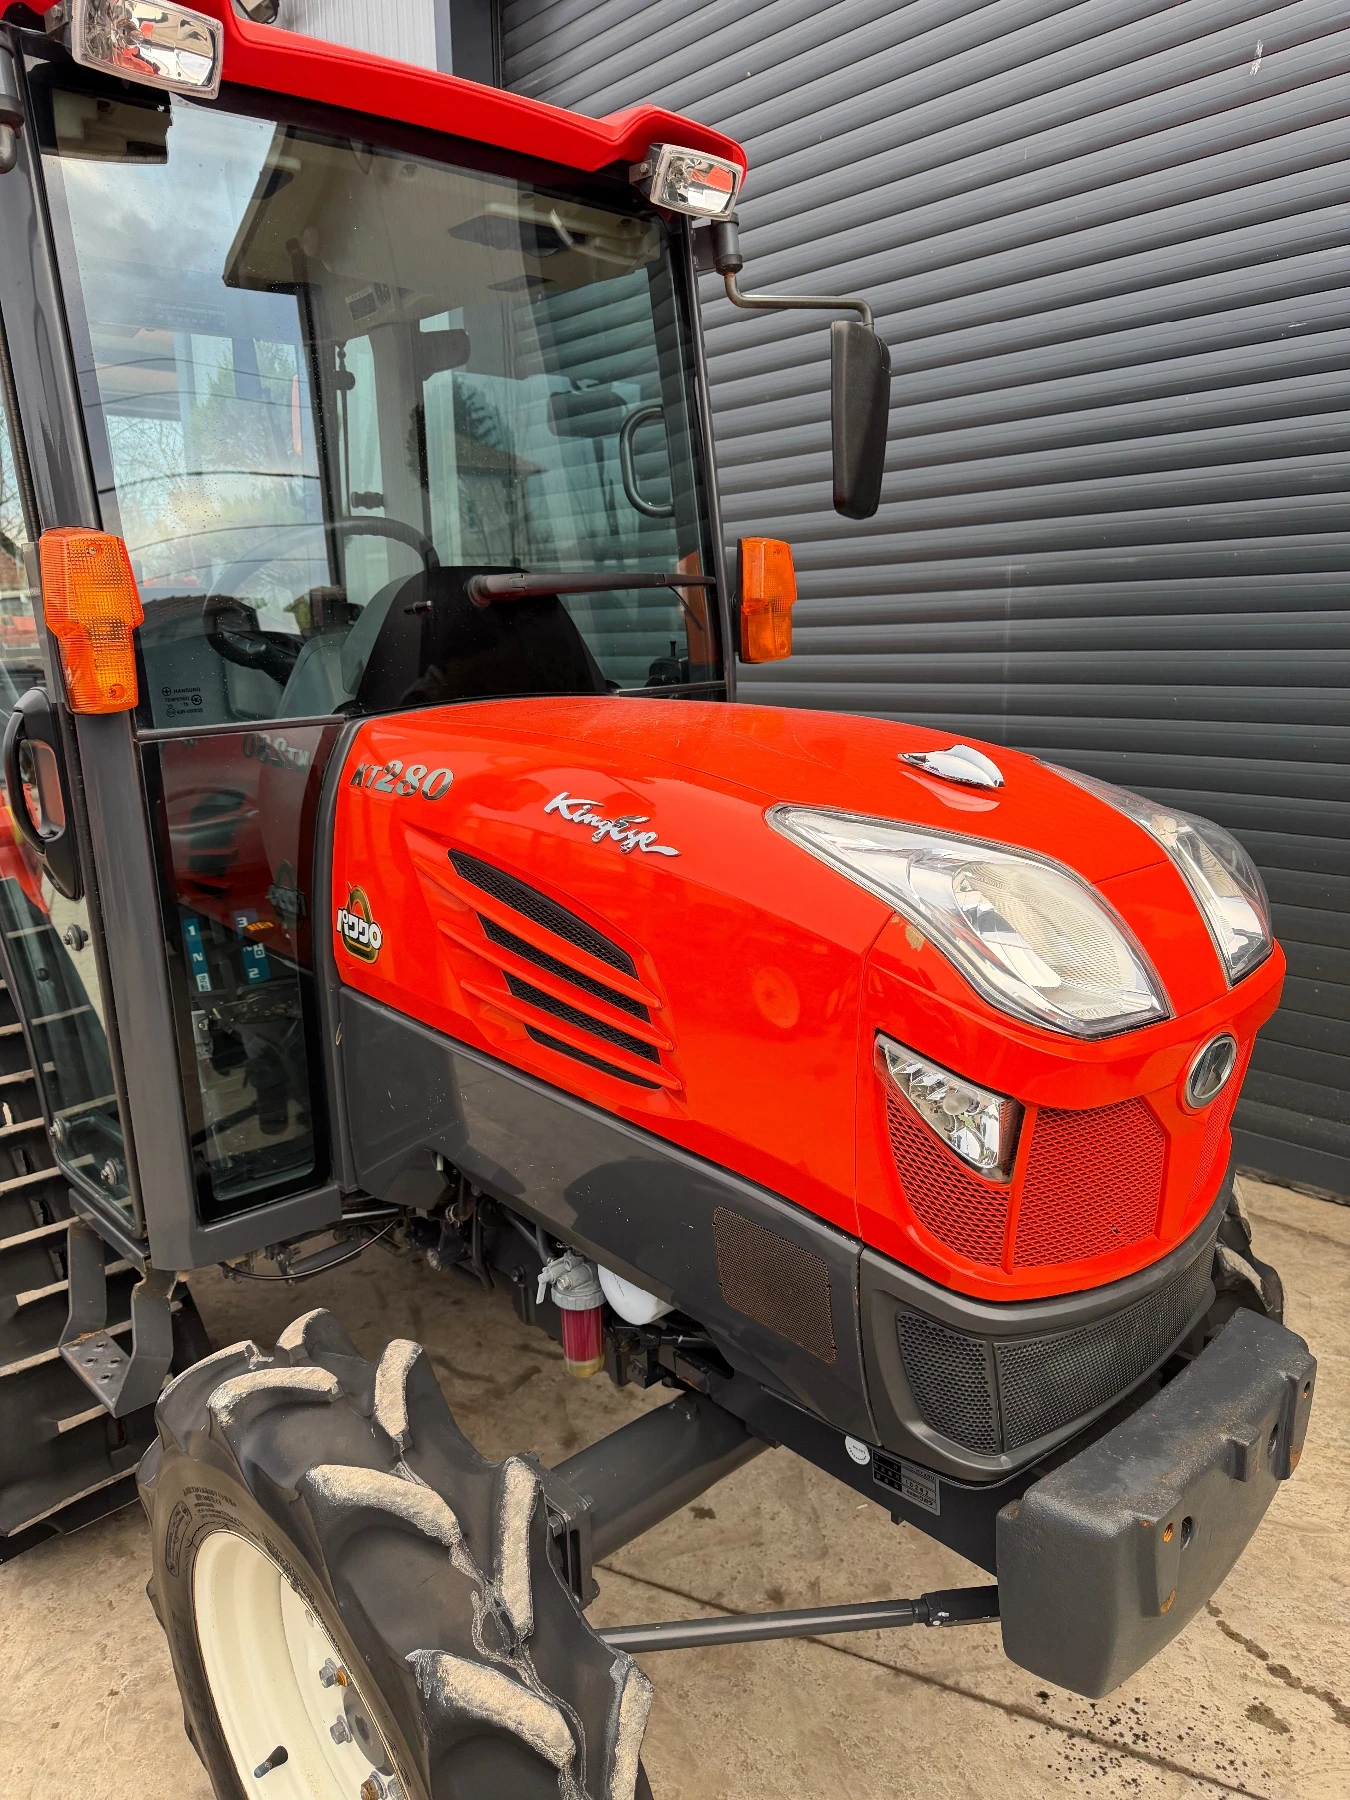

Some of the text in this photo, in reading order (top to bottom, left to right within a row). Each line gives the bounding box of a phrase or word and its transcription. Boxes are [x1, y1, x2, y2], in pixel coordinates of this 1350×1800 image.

[350, 760, 454, 801] KT280
[237, 916, 248, 928] 3
[187, 925, 196, 936] 1
[336, 909, 383, 950] パワクロ
[248, 967, 260, 979] 2
